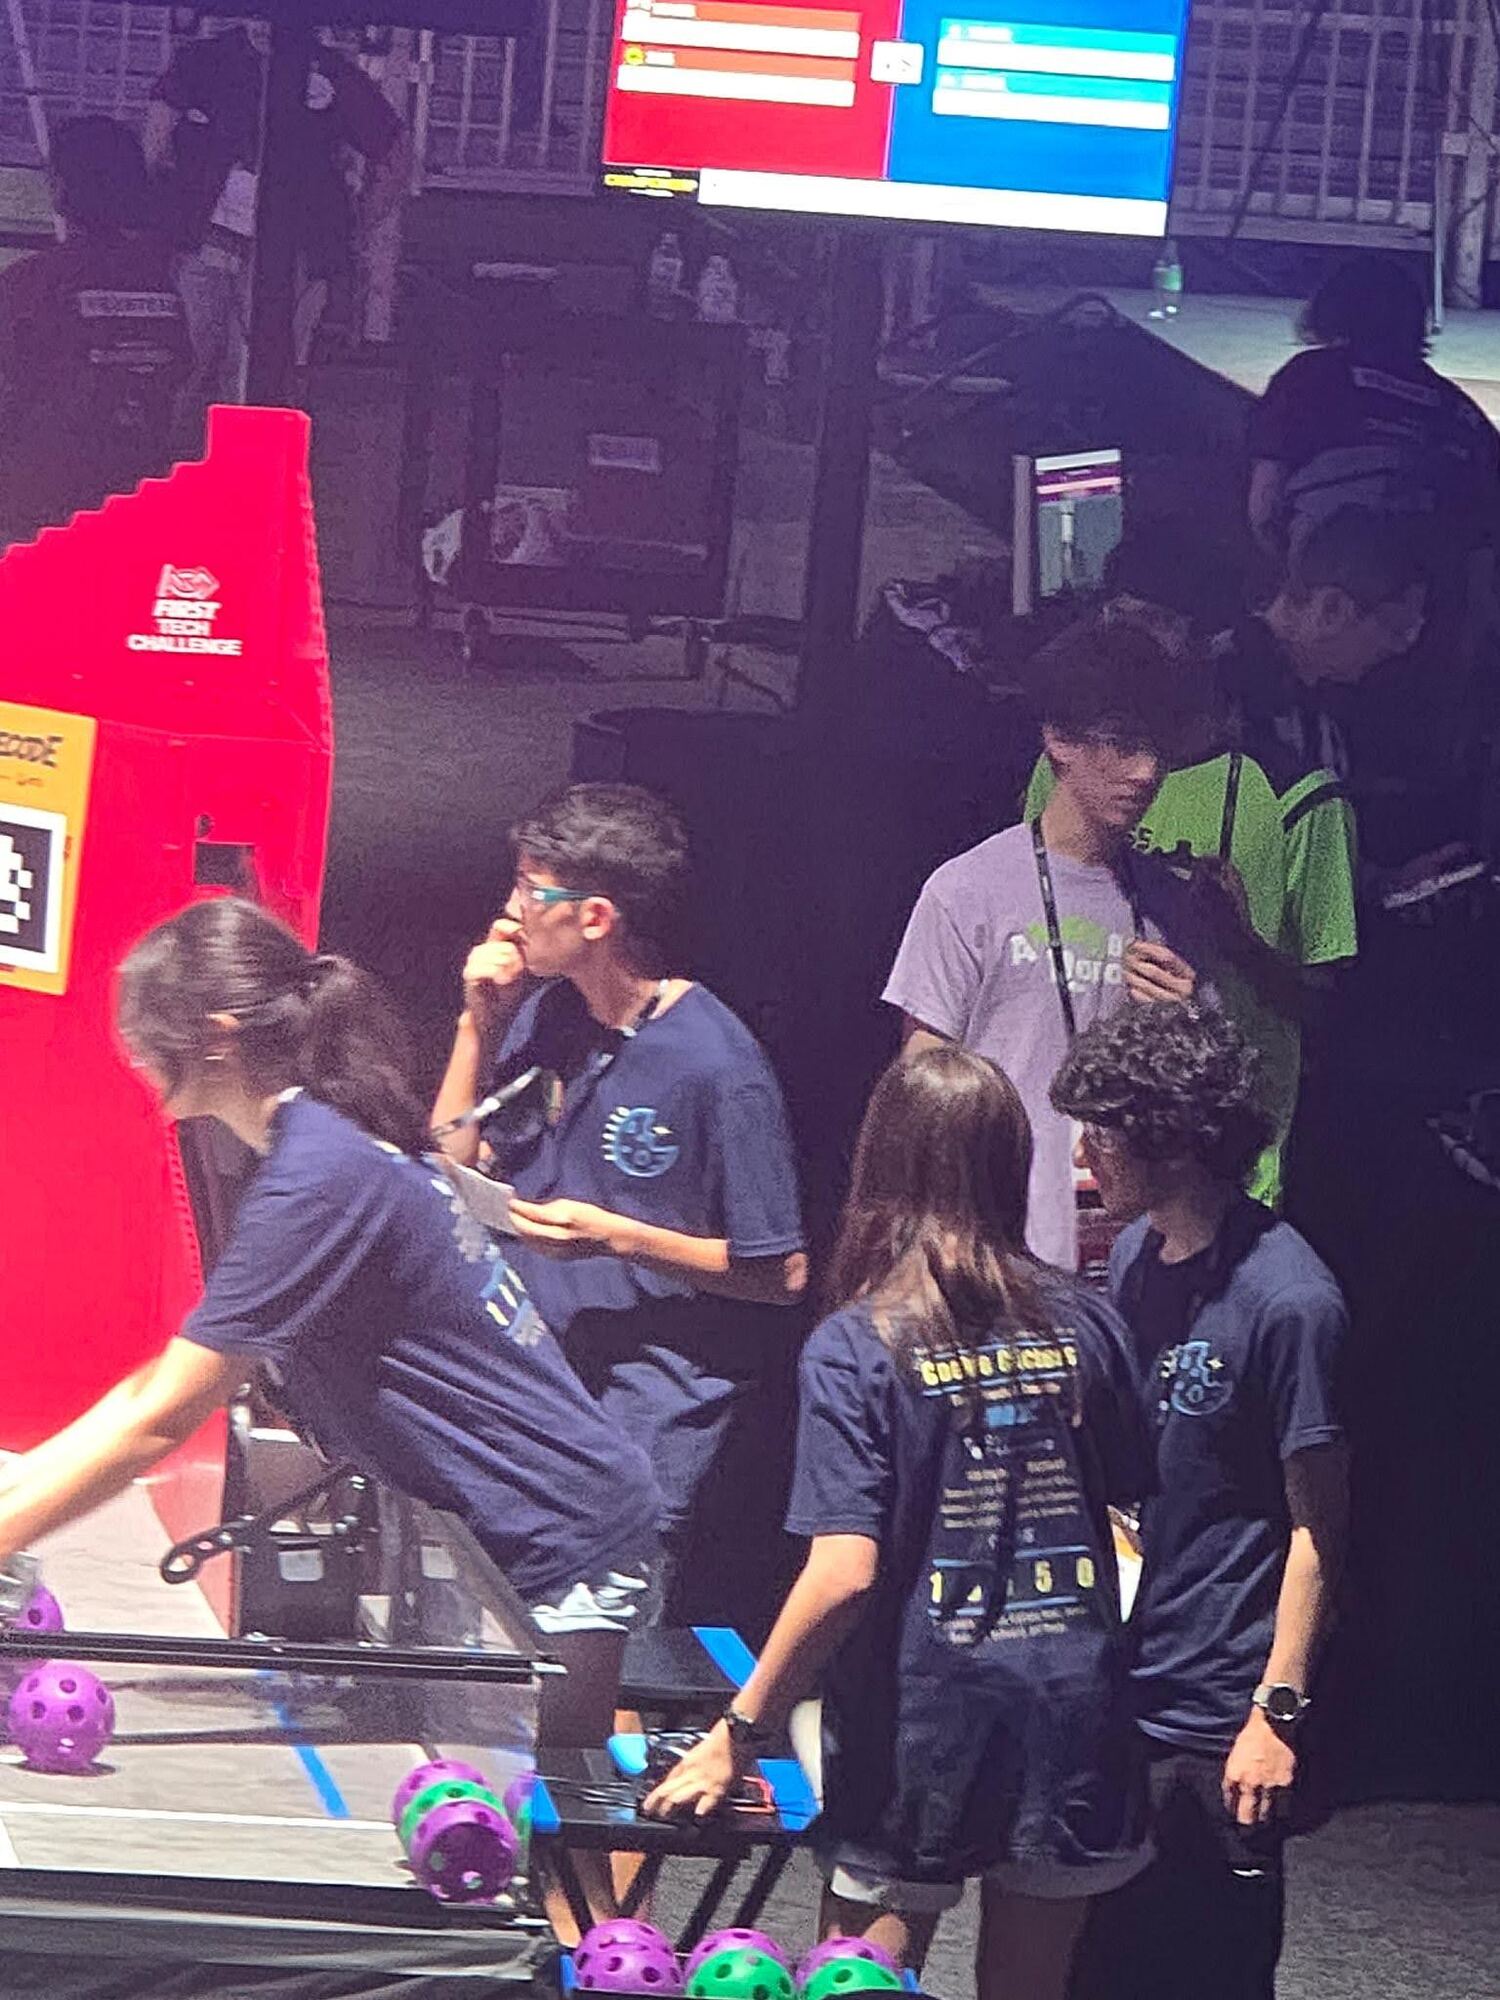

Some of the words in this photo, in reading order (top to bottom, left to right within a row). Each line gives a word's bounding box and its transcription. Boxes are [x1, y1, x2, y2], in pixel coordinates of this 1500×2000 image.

[151, 599, 222, 619] FIRST
[156, 618, 211, 636] TECH
[127, 633, 242, 656] CHALLENGE
